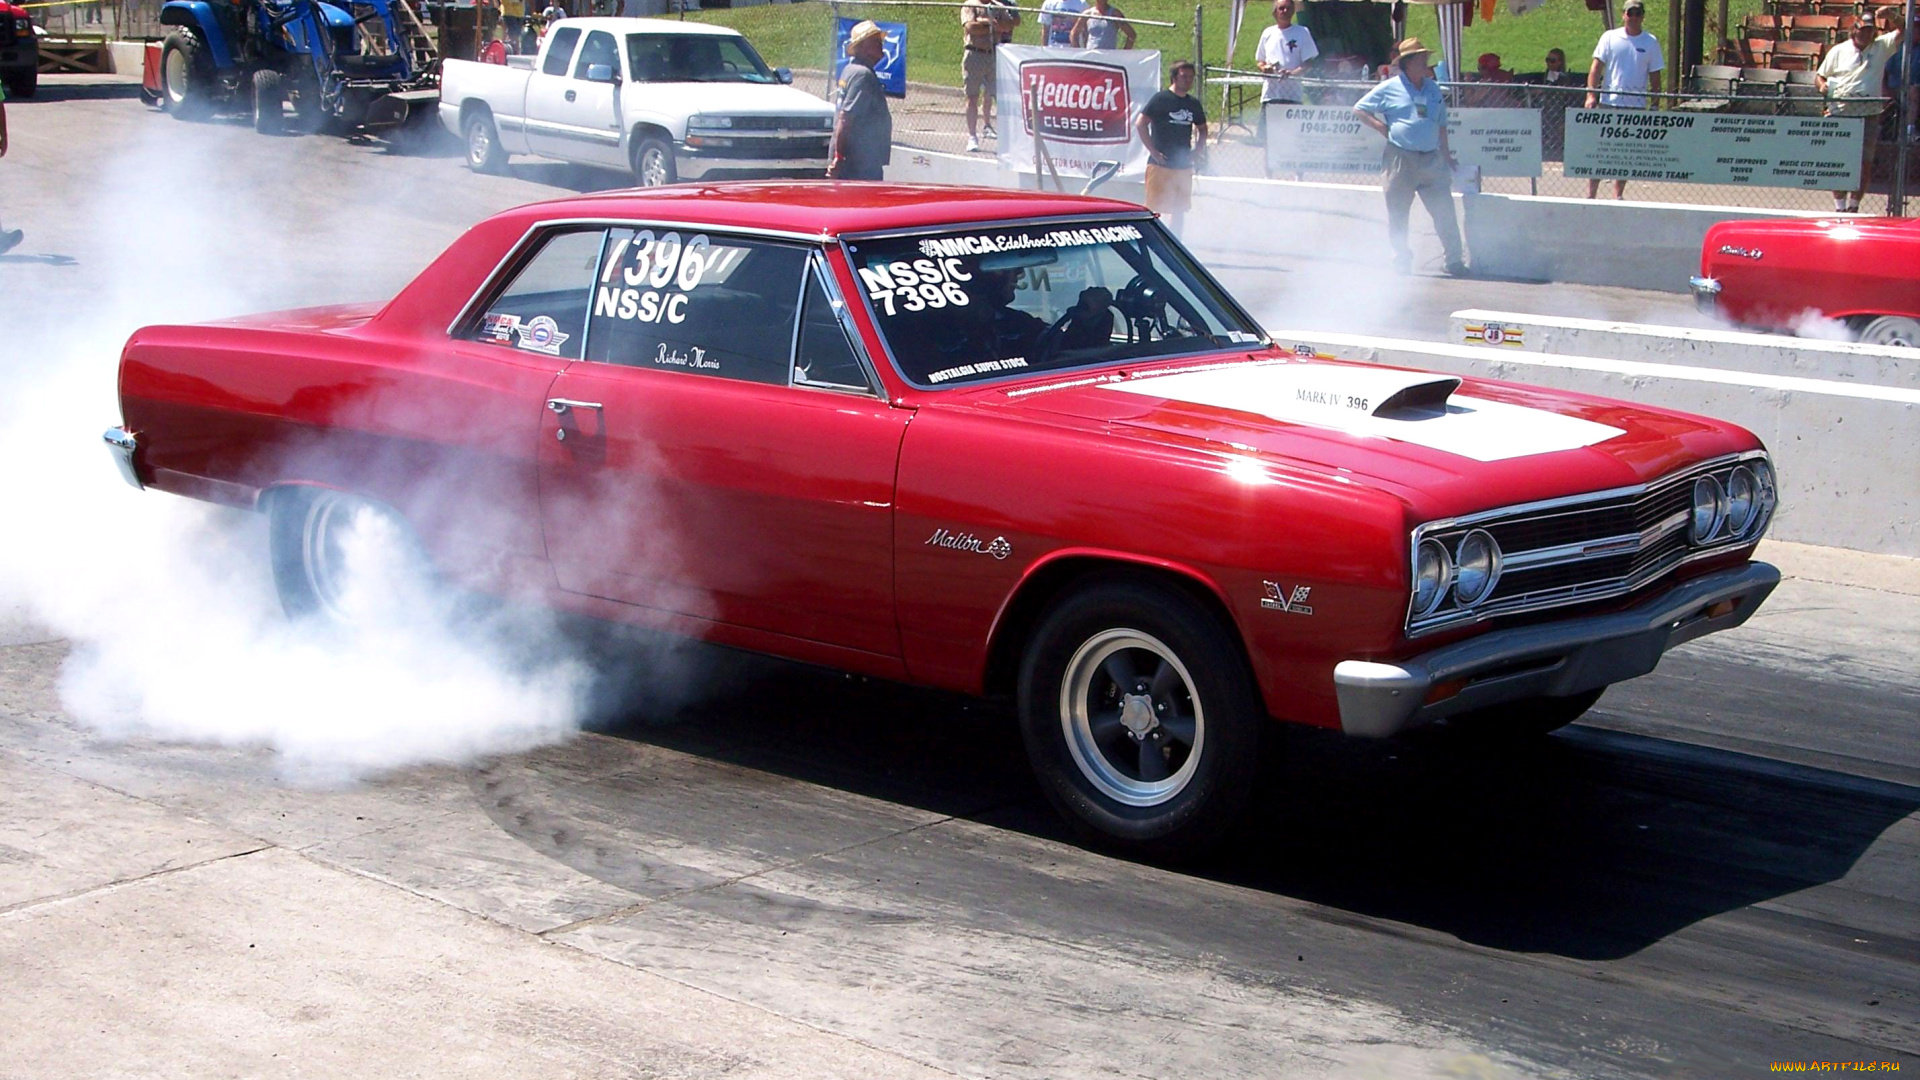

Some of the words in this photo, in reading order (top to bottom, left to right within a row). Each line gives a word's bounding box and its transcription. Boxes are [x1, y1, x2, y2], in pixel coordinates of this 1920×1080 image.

[1028, 74, 1121, 111] Heacock
[1286, 109, 1314, 120] GARY
[1575, 112, 1613, 125] CHRIS
[1616, 113, 1694, 128] THOMERSON
[1747, 118, 1766, 126] QUICK
[1800, 120, 1820, 128] BEECH
[1600, 127, 1668, 140] 1966-2007
[1710, 126, 1743, 134] SHOOTOUT
[1743, 127, 1777, 135] CHAMPION
[1735, 157, 1768, 165] IMPROVED
[1800, 160, 1815, 168] CITY
[1815, 161, 1845, 169] RACEWAY
[1596, 167, 1629, 177] HEADED
[1631, 169, 1663, 178] RACING
[1730, 166, 1753, 174] DRIVER
[1772, 168, 1796, 176] TROPHY
[1797, 169, 1815, 177] CLASS
[1816, 170, 1851, 178] CHAMPION
[931, 235, 1000, 258] NMCA
[996, 233, 1055, 252] Edelbrock
[1052, 228, 1092, 247] DRAG
[1092, 225, 1143, 243] RACING
[858, 257, 973, 293] NSS/C
[594, 286, 689, 324] NSS/C
[869, 282, 970, 316] 7396
[655, 342, 688, 365] Richard
[689, 346, 720, 369] Morris
[927, 364, 977, 384] NOSTALGIA
[973, 360, 1002, 373] SUPER
[999, 357, 1029, 369] STOCK
[1296, 388, 1327, 405] MARK
[1329, 393, 1341, 406] IV
[1346, 396, 1368, 411] 396
[925, 528, 985, 553] Malibu
